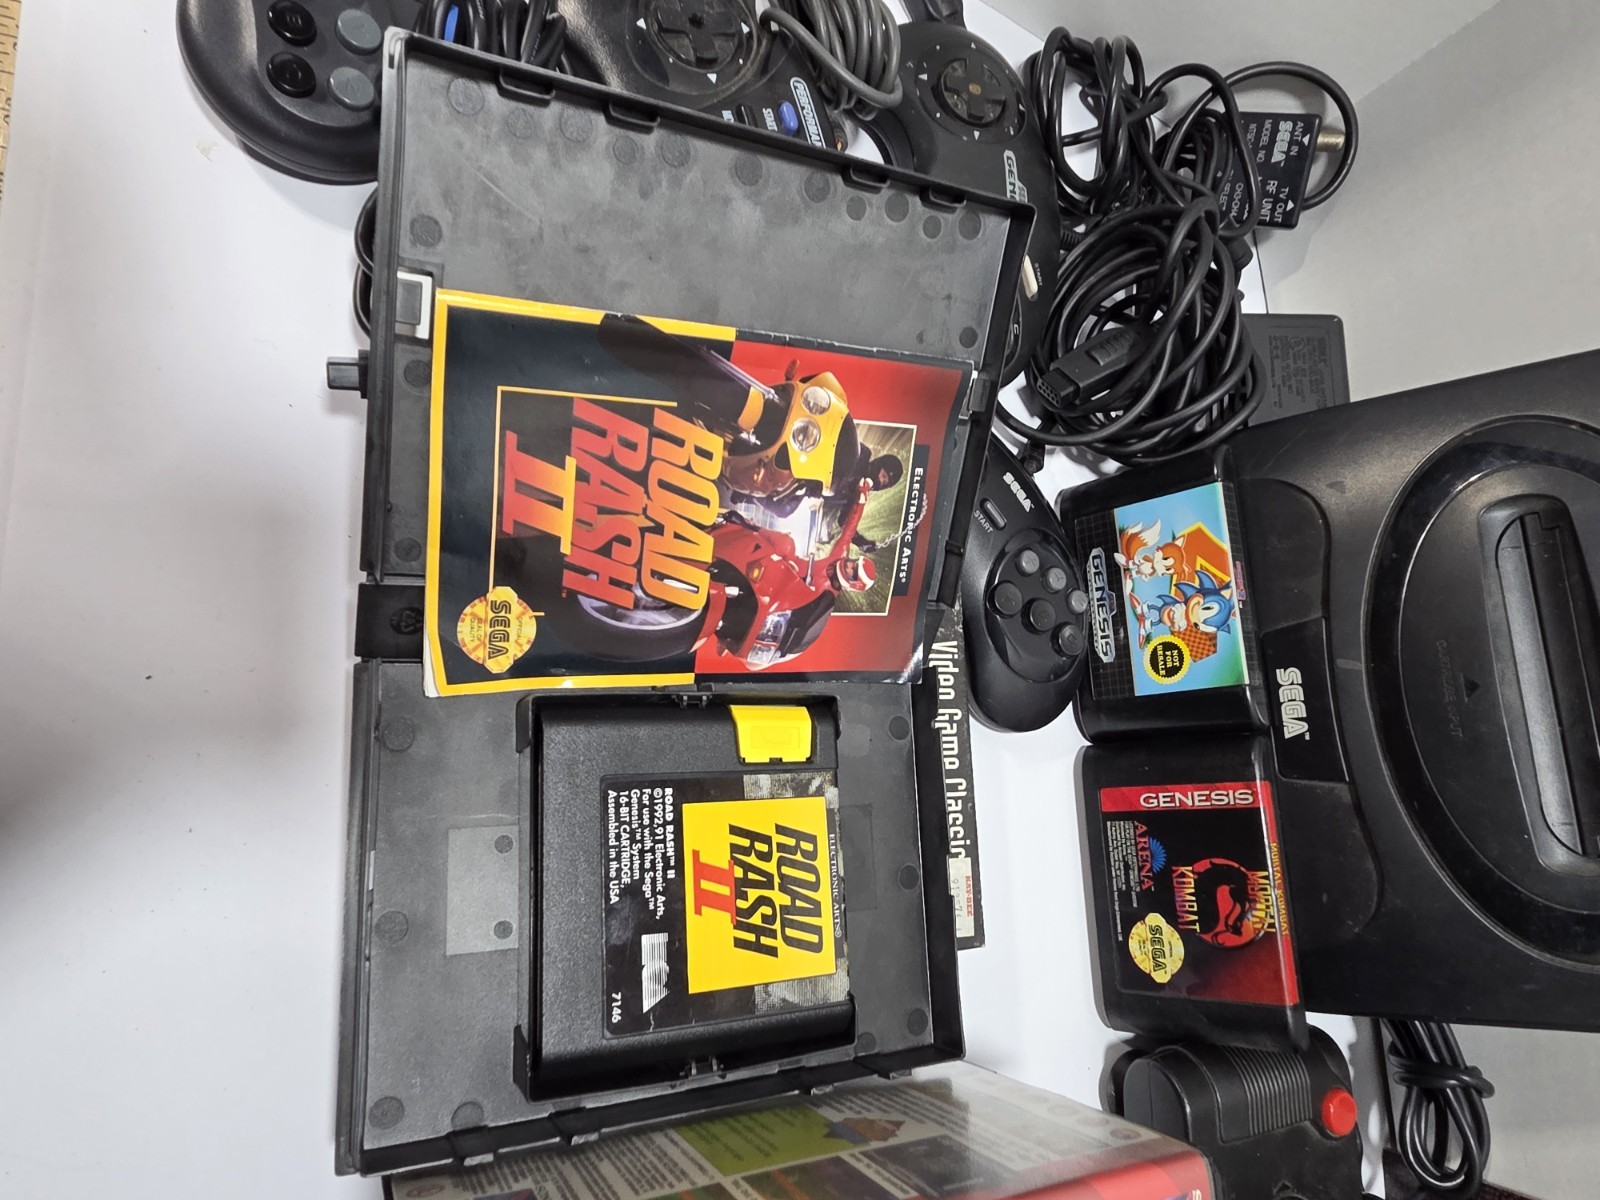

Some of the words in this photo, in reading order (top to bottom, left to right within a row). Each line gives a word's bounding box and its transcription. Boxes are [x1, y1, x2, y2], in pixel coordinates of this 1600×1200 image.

[1259, 119, 1273, 147] MODEL
[1271, 121, 1293, 164] SEGA
[1293, 121, 1305, 141] ANT
[1289, 146, 1299, 156] IN
[1266, 180, 1278, 195] RF
[1279, 187, 1289, 199] TV
[1260, 198, 1273, 223] UNIT
[1274, 202, 1285, 223] OUT
[502, 430, 577, 555] II
[561, 396, 650, 609] RASH
[640, 406, 725, 610] ROAD
[1003, 472, 1032, 513] SEGA
[974, 510, 994, 533] START
[1091, 554, 1112, 657] GENESIS
[488, 600, 511, 660] SEGA
[928, 640, 959, 700] Video
[1156, 644, 1166, 676] RESALE
[1165, 650, 1173, 668] FOR
[1172, 649, 1180, 667] NOT
[1276, 667, 1308, 739] SEGA
[934, 708, 962, 770] Game
[619, 790, 629, 822] 16-BIT
[642, 789, 652, 805] For
[664, 788, 674, 821] ROAD
[1139, 790, 1254, 808] GENESIS
[608, 790, 619, 845] Assembled
[643, 808, 651, 826] use
[609, 848, 619, 858] in
[643, 828, 653, 850] with
[1134, 821, 1154, 890] ARENA
[610, 861, 619, 877] the
[619, 825, 630, 889] CARTRIDGE,
[630, 843, 642, 880] System
[644, 853, 654, 869] the
[655, 843, 665, 892] Electronic
[829, 834, 839, 899] ELECTRONIC
[1271, 842, 1281, 887] MORTAL
[666, 869, 675, 879] II
[692, 849, 737, 926] II
[774, 823, 824, 954] ROAD
[610, 880, 619, 905] USA
[655, 895, 666, 920] Arts,
[728, 823, 779, 959] RASH
[1172, 866, 1201, 933] KOMBAT
[1274, 888, 1289, 937] KOMBAT
[1149, 925, 1167, 972] SEGA
[611, 991, 622, 1023] 7146
